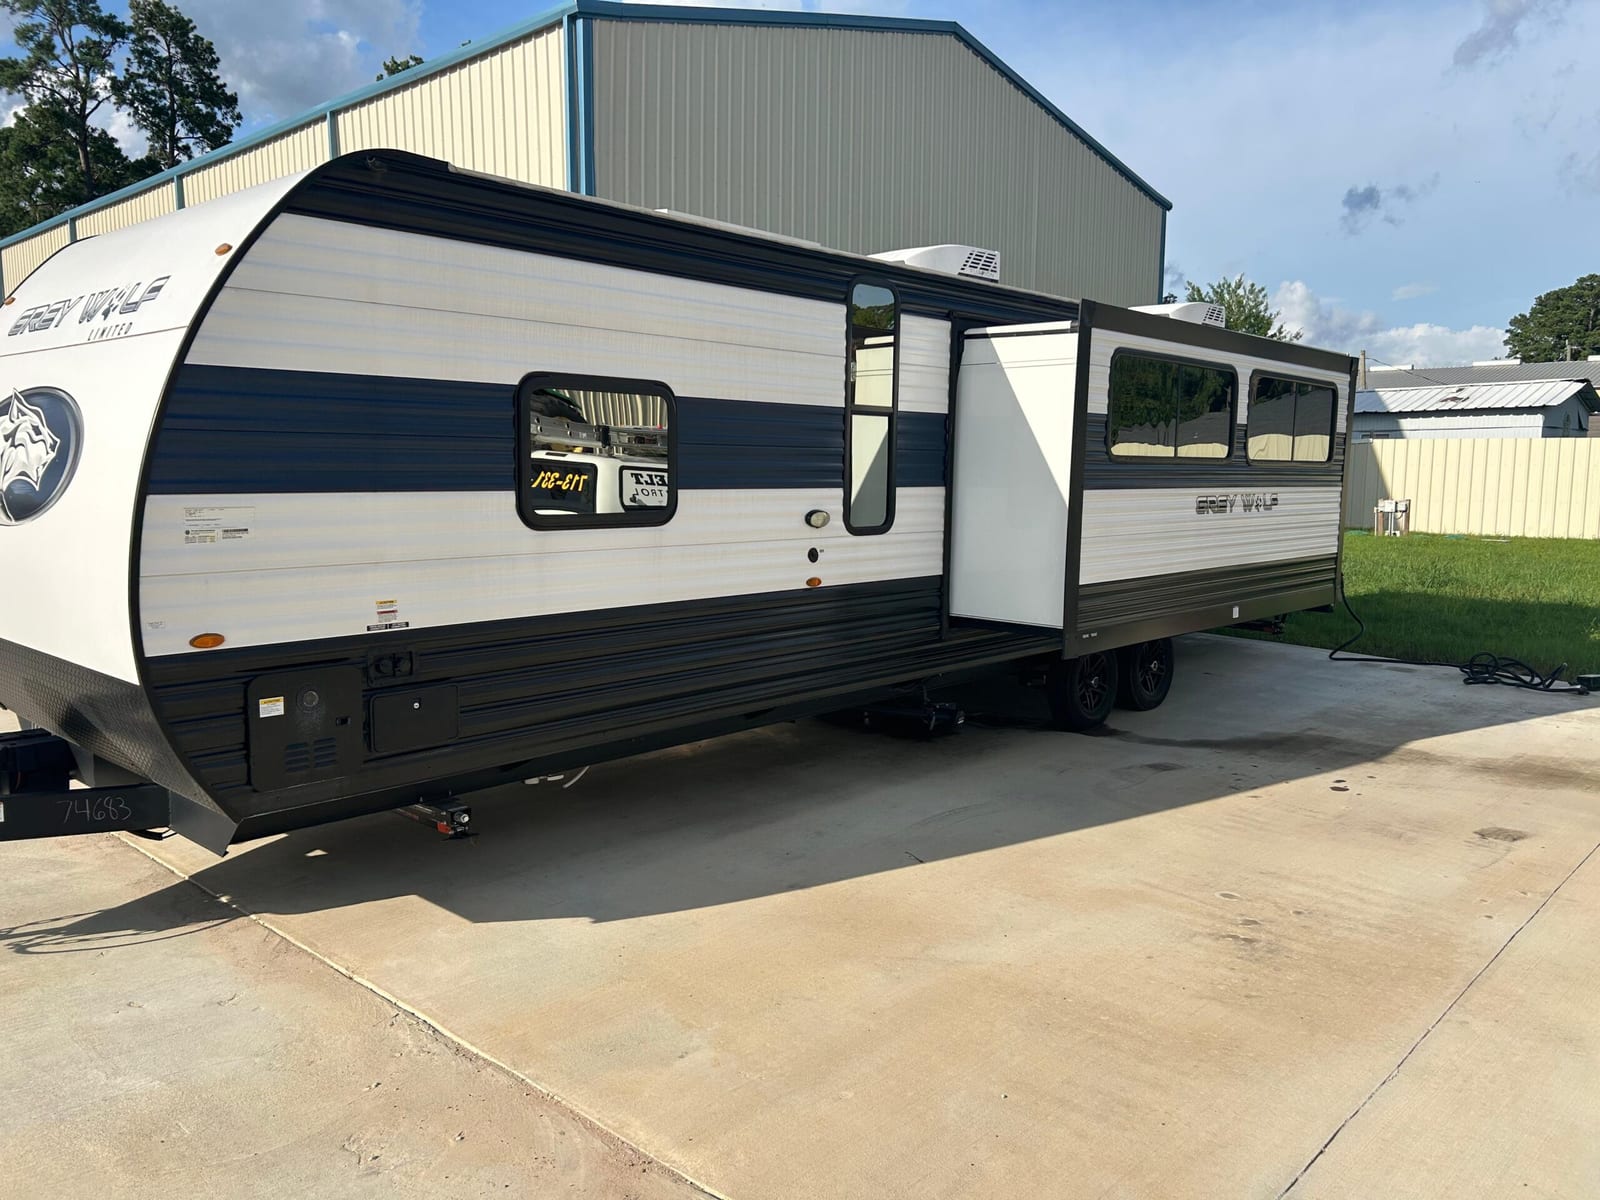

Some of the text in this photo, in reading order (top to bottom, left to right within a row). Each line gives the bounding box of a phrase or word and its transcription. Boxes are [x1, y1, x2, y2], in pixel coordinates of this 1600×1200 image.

[8, 295, 85, 337] GREY
[87, 321, 134, 341] LIMITED
[1195, 493, 1238, 515] GREY
[56, 796, 132, 824] 74683
